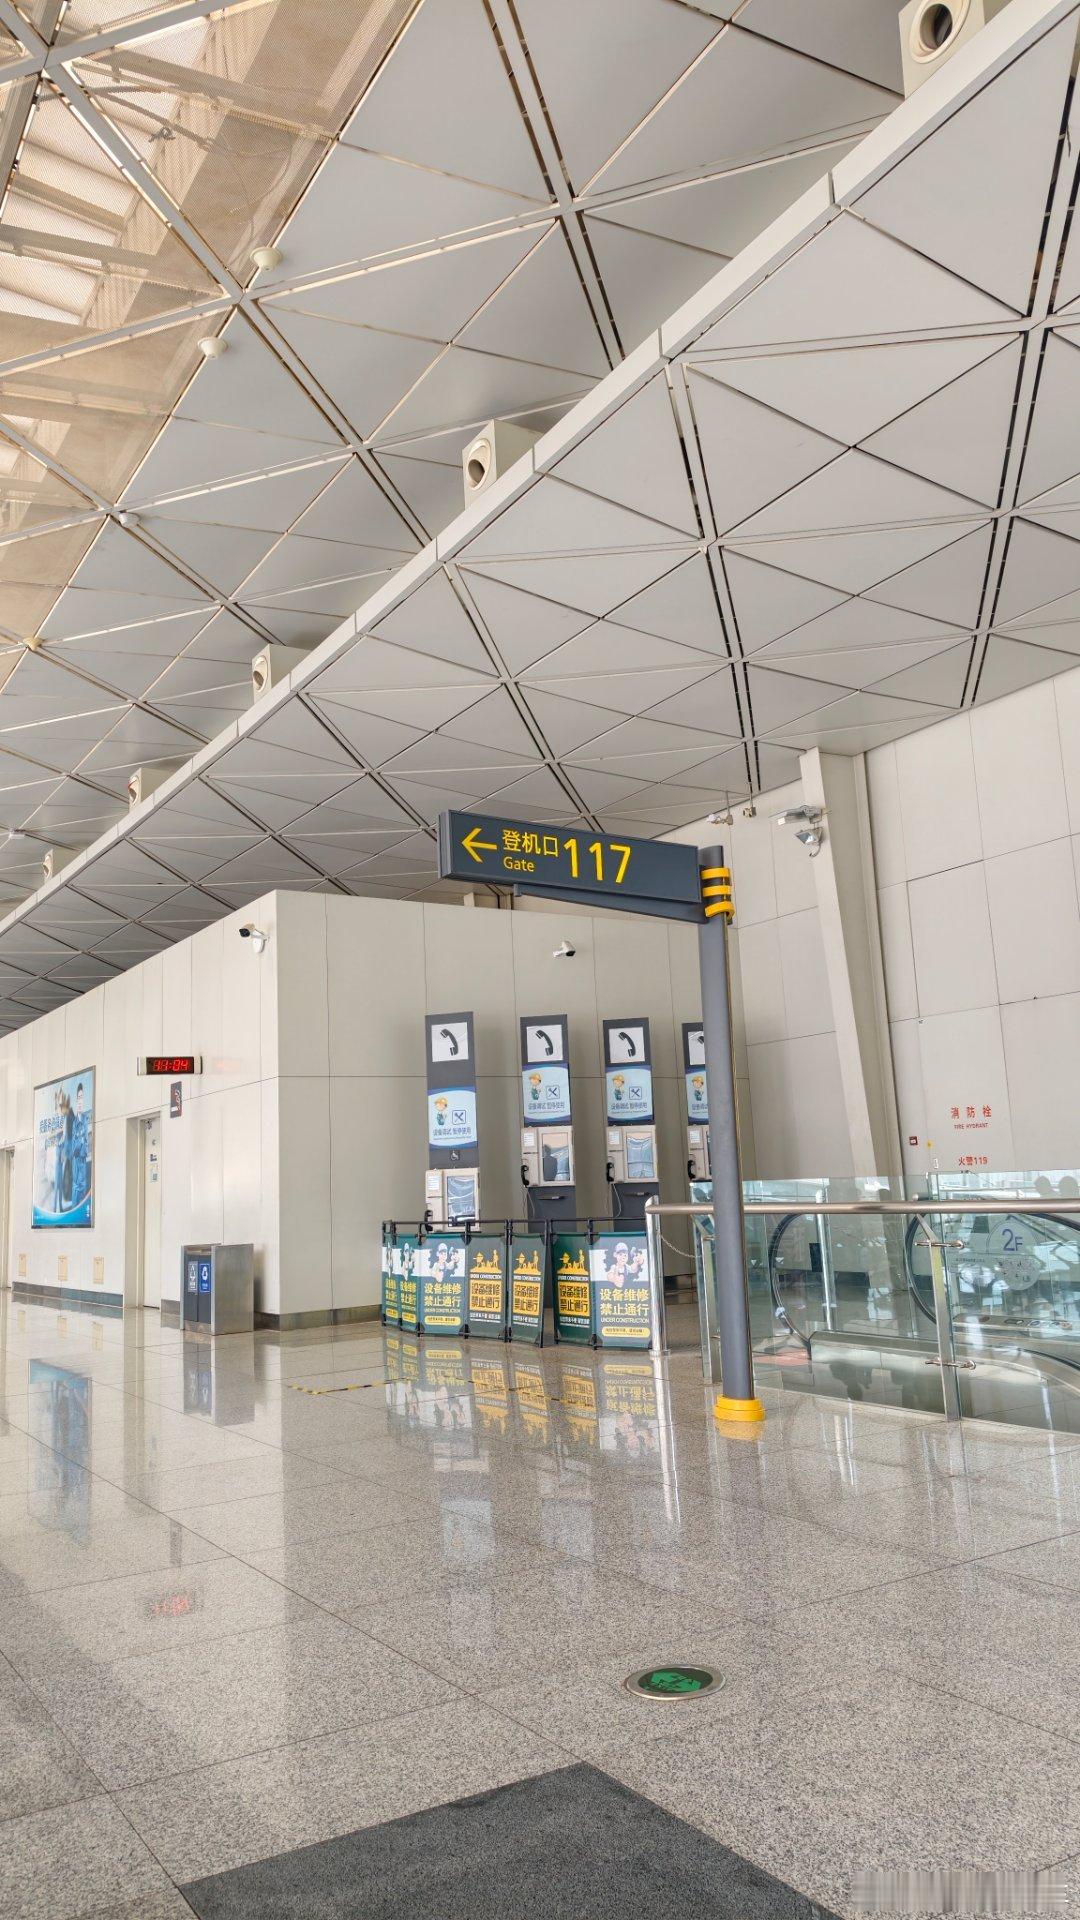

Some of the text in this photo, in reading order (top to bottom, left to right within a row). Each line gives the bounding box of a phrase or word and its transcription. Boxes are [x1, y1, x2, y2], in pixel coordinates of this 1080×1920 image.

[502, 829, 632, 884] 登机口 117
[503, 856, 535, 872] Gate
[154, 1058, 188, 1072] 11:04
[951, 1104, 992, 1119] 消防栓
[958, 1156, 988, 1165] 火警119
[1002, 1229, 1023, 1251] 2F
[424, 1282, 462, 1294] 设备维修
[600, 1288, 649, 1301] 设备维修
[424, 1295, 461, 1307] 禁止通行
[600, 1303, 649, 1316] 禁止通行
